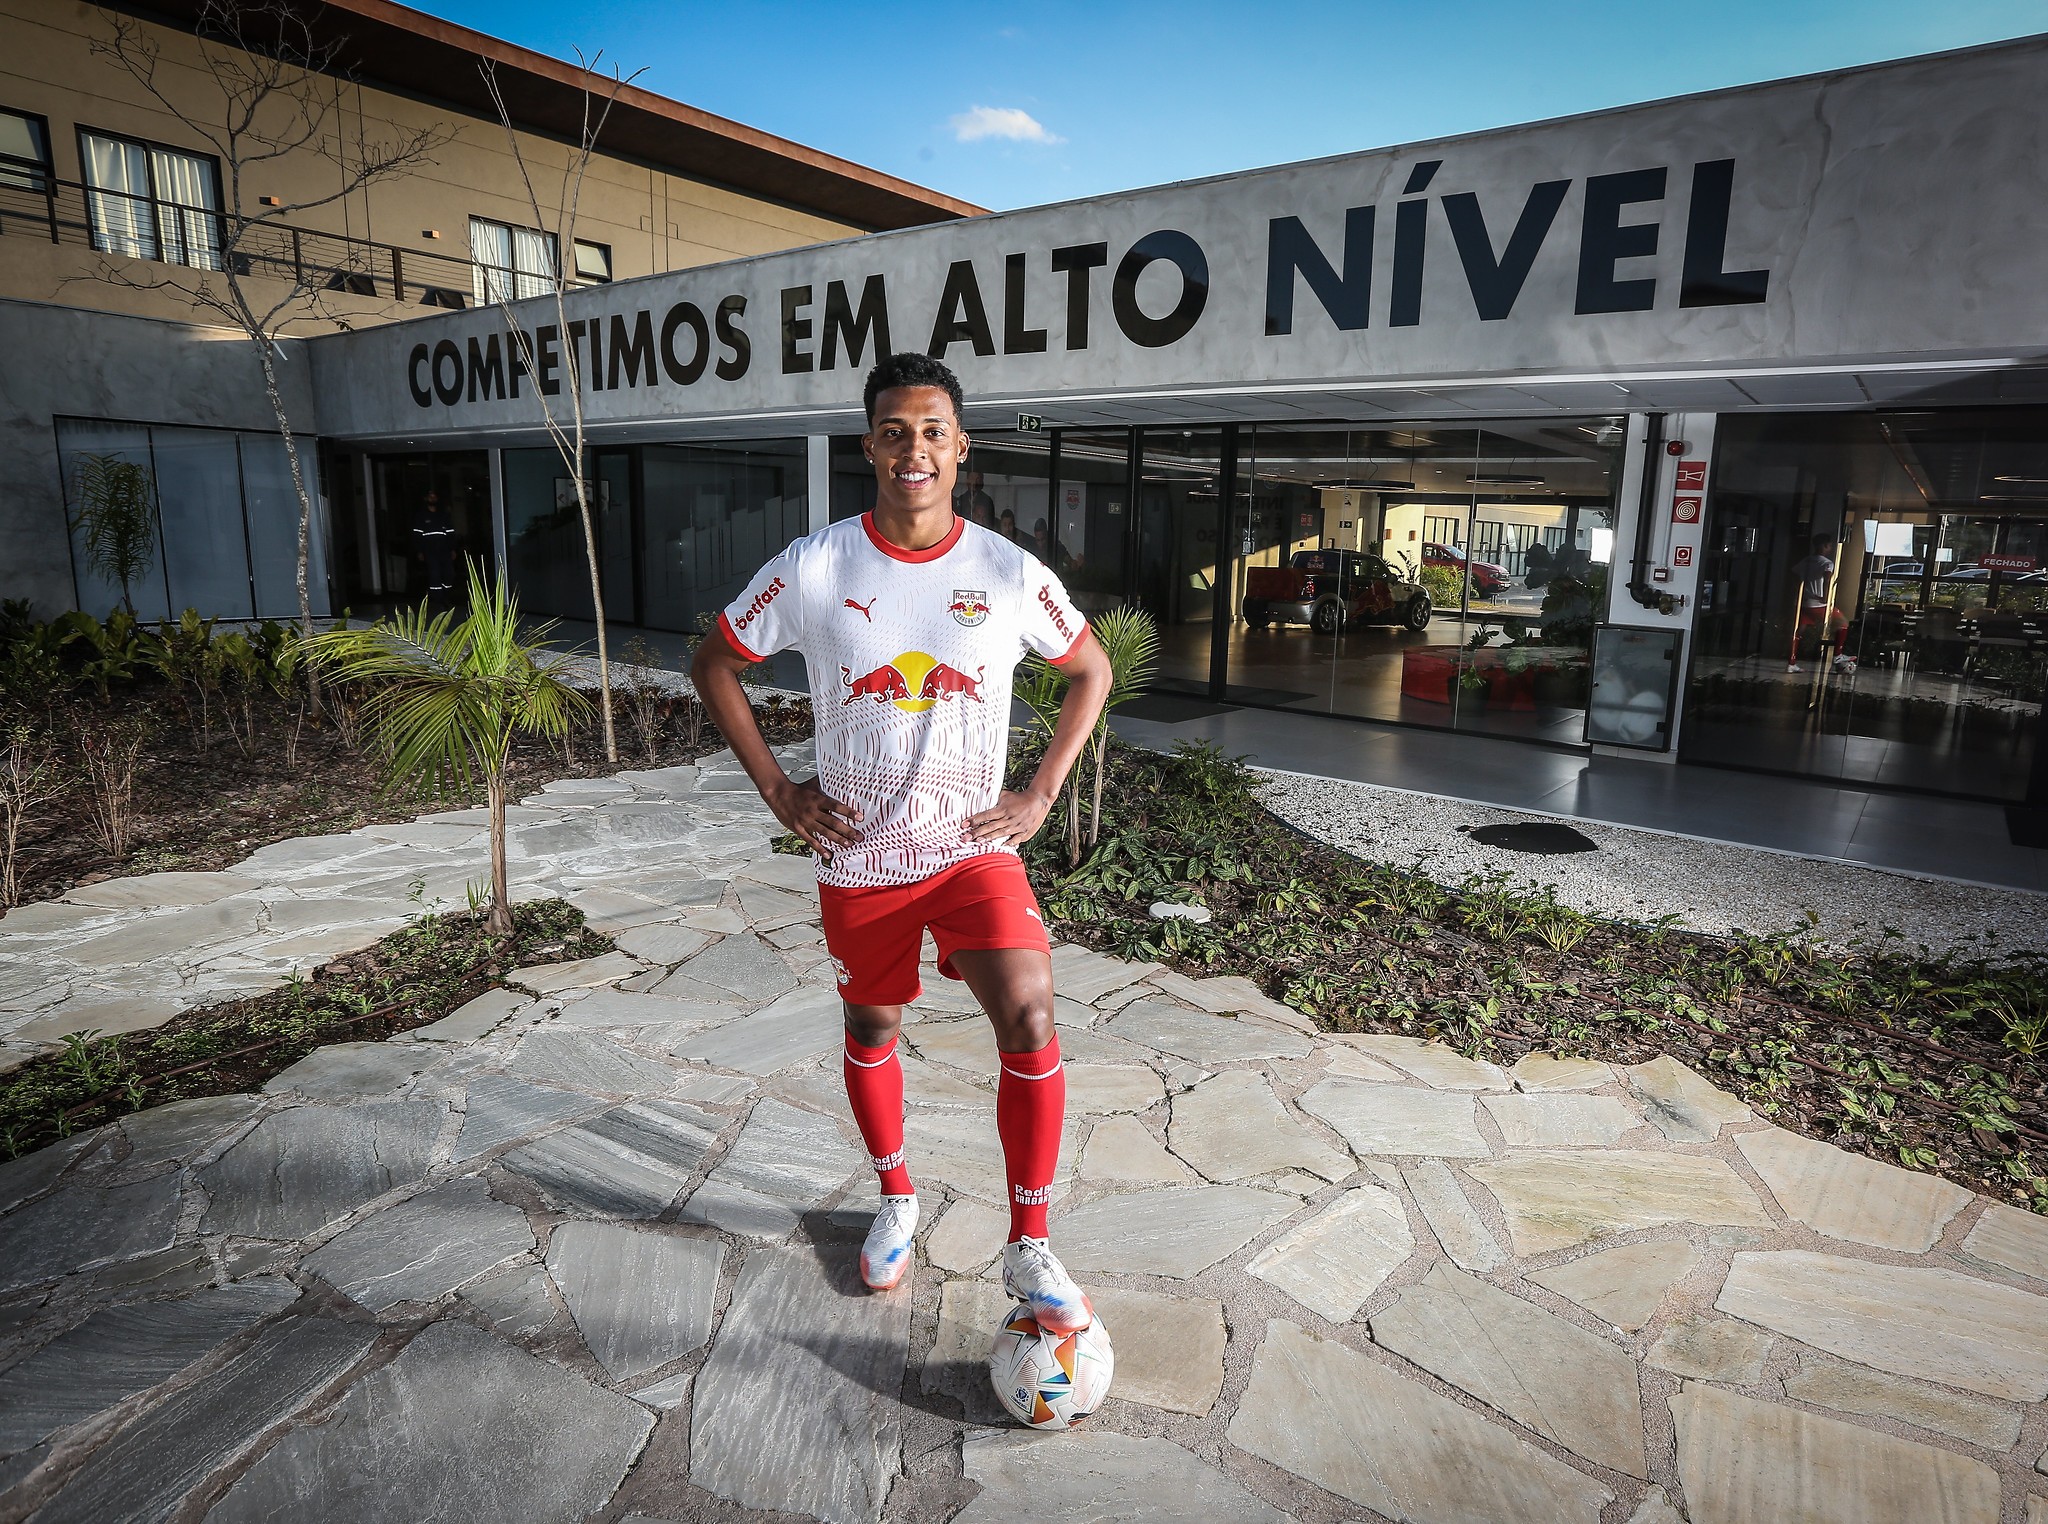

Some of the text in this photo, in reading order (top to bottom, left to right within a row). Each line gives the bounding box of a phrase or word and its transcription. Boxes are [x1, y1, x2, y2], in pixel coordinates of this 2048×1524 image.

[408, 158, 1771, 409] COMPETIMOS EM ALTO NÍVEL
[1983, 558, 2031, 568] FECHADO
[735, 577, 785, 631] betfast
[1038, 584, 1074, 643] betfast
